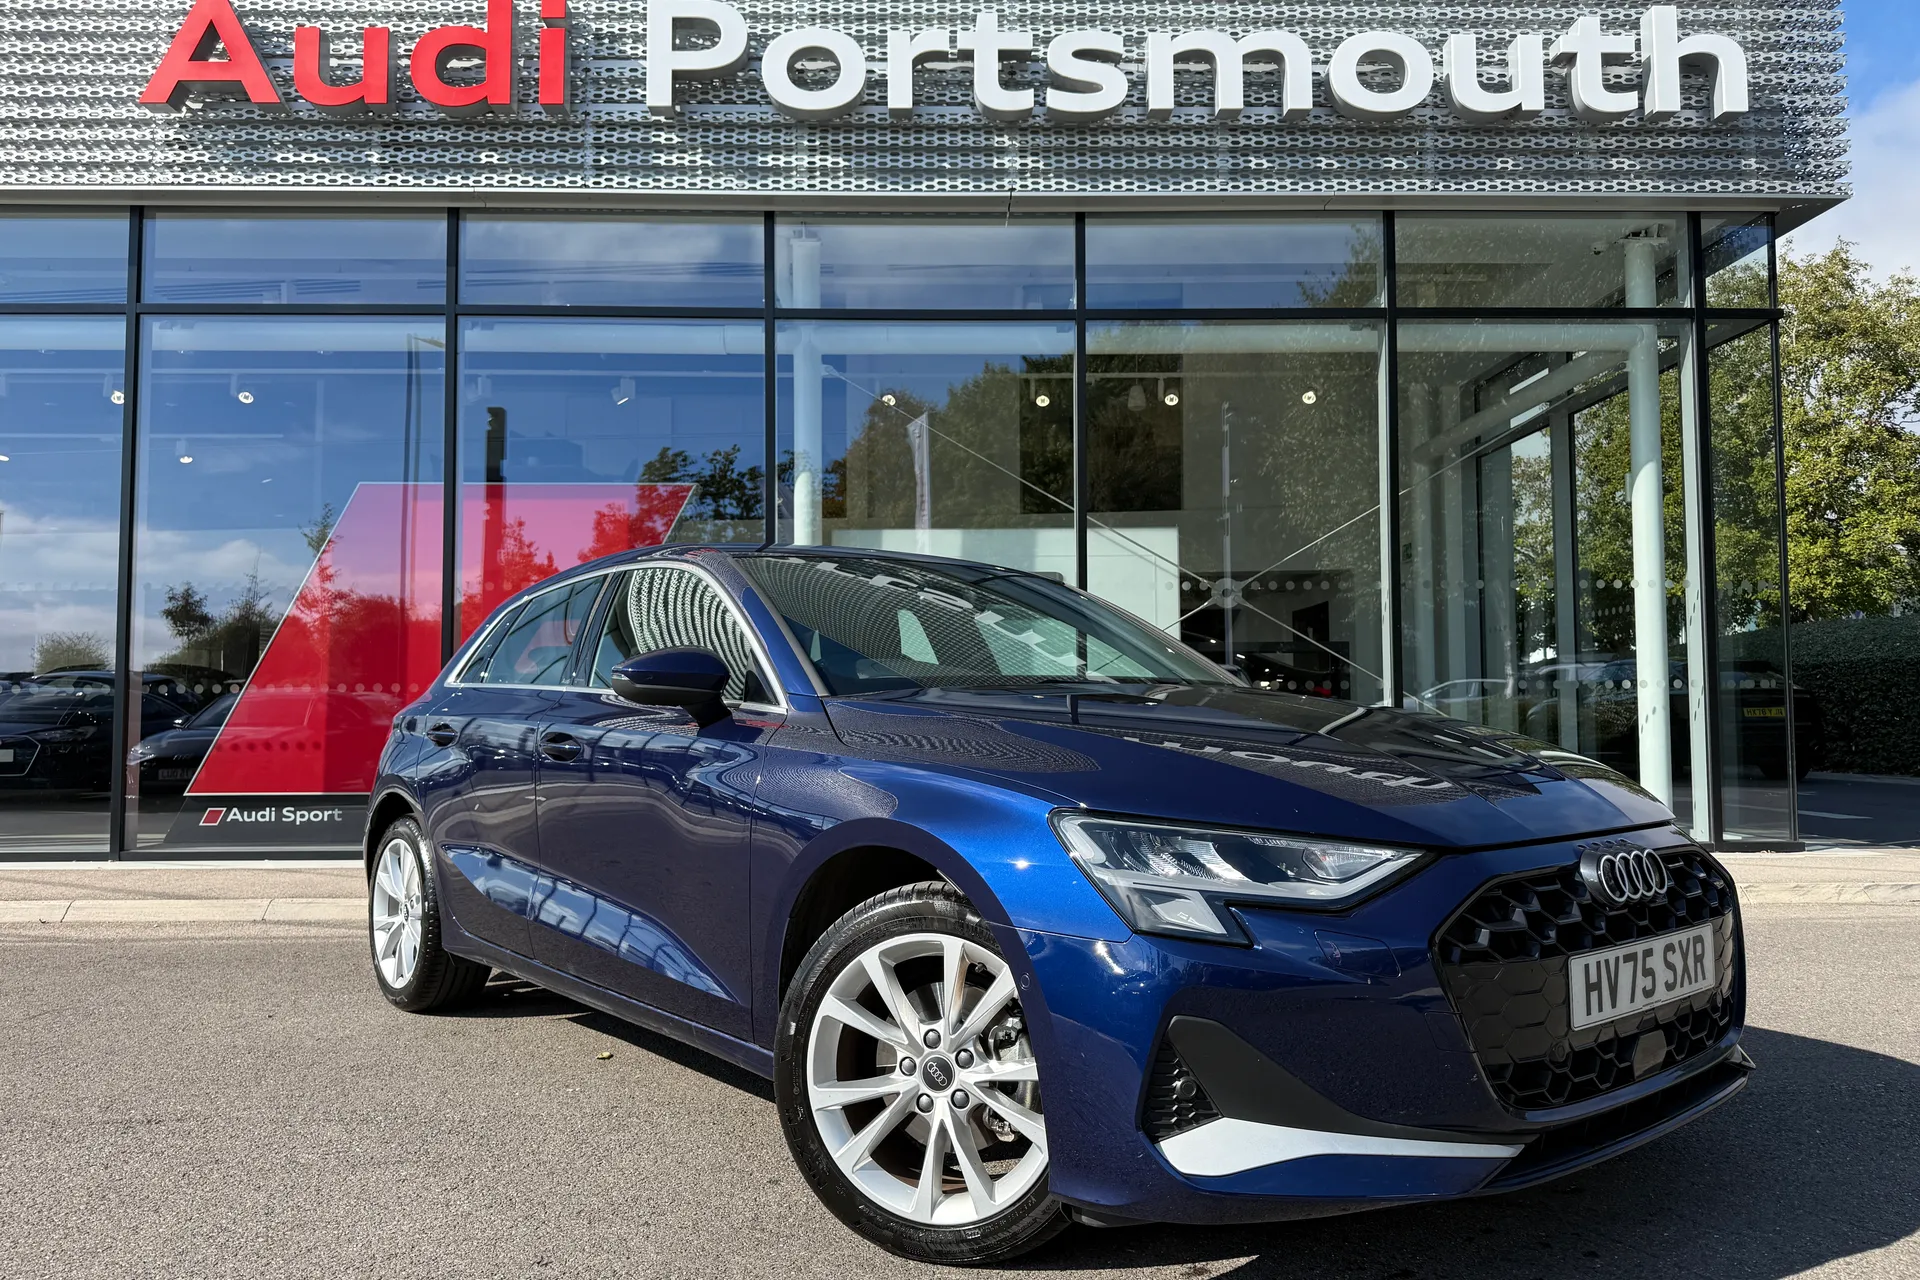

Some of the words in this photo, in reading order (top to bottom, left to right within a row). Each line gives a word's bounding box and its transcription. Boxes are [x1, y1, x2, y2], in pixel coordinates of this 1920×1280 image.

[139, 0, 567, 108] Audi
[646, 0, 1749, 118] Portsmouth
[226, 807, 275, 822] Audi
[282, 806, 343, 825] Sport
[1584, 947, 1656, 1016] HV75
[1663, 934, 1706, 992] SXR
